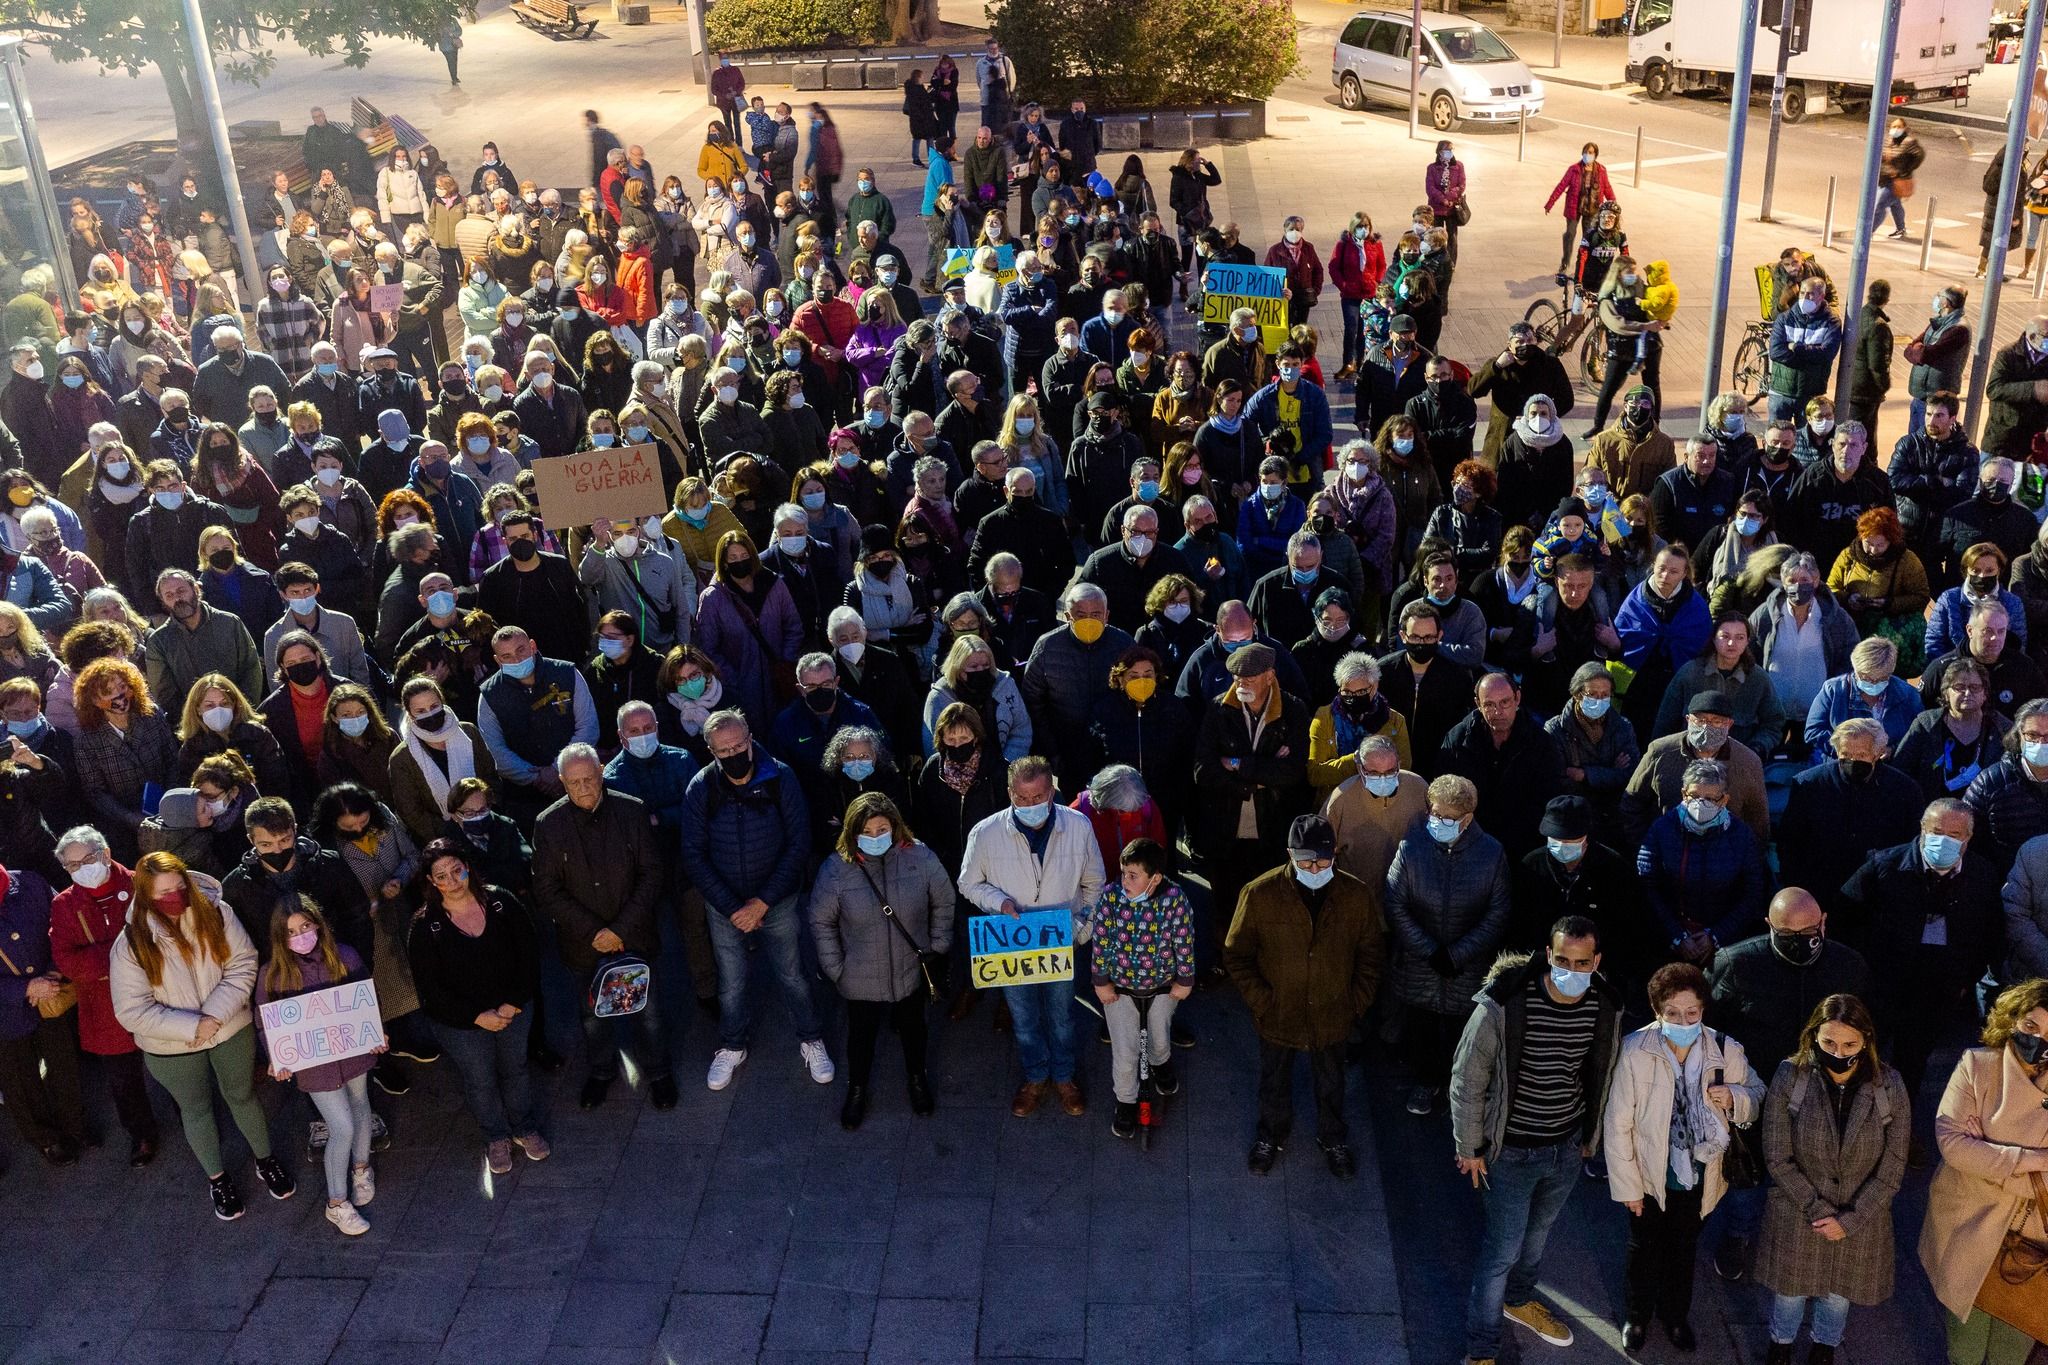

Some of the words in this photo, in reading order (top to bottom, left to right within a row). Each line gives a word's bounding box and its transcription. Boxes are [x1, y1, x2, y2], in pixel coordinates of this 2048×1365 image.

[2031, 95, 2048, 115] TOP
[1207, 269, 1243, 293] STOP
[564, 462, 593, 478] NO
[598, 458, 612, 471] A
[619, 450, 644, 468] LA
[575, 467, 653, 492] GUERRA
[979, 955, 1072, 982] GUERRA
[262, 999, 302, 1031] NO
[306, 992, 332, 1019] A
[334, 983, 375, 1013] LA
[273, 1021, 382, 1065] GUERRA
